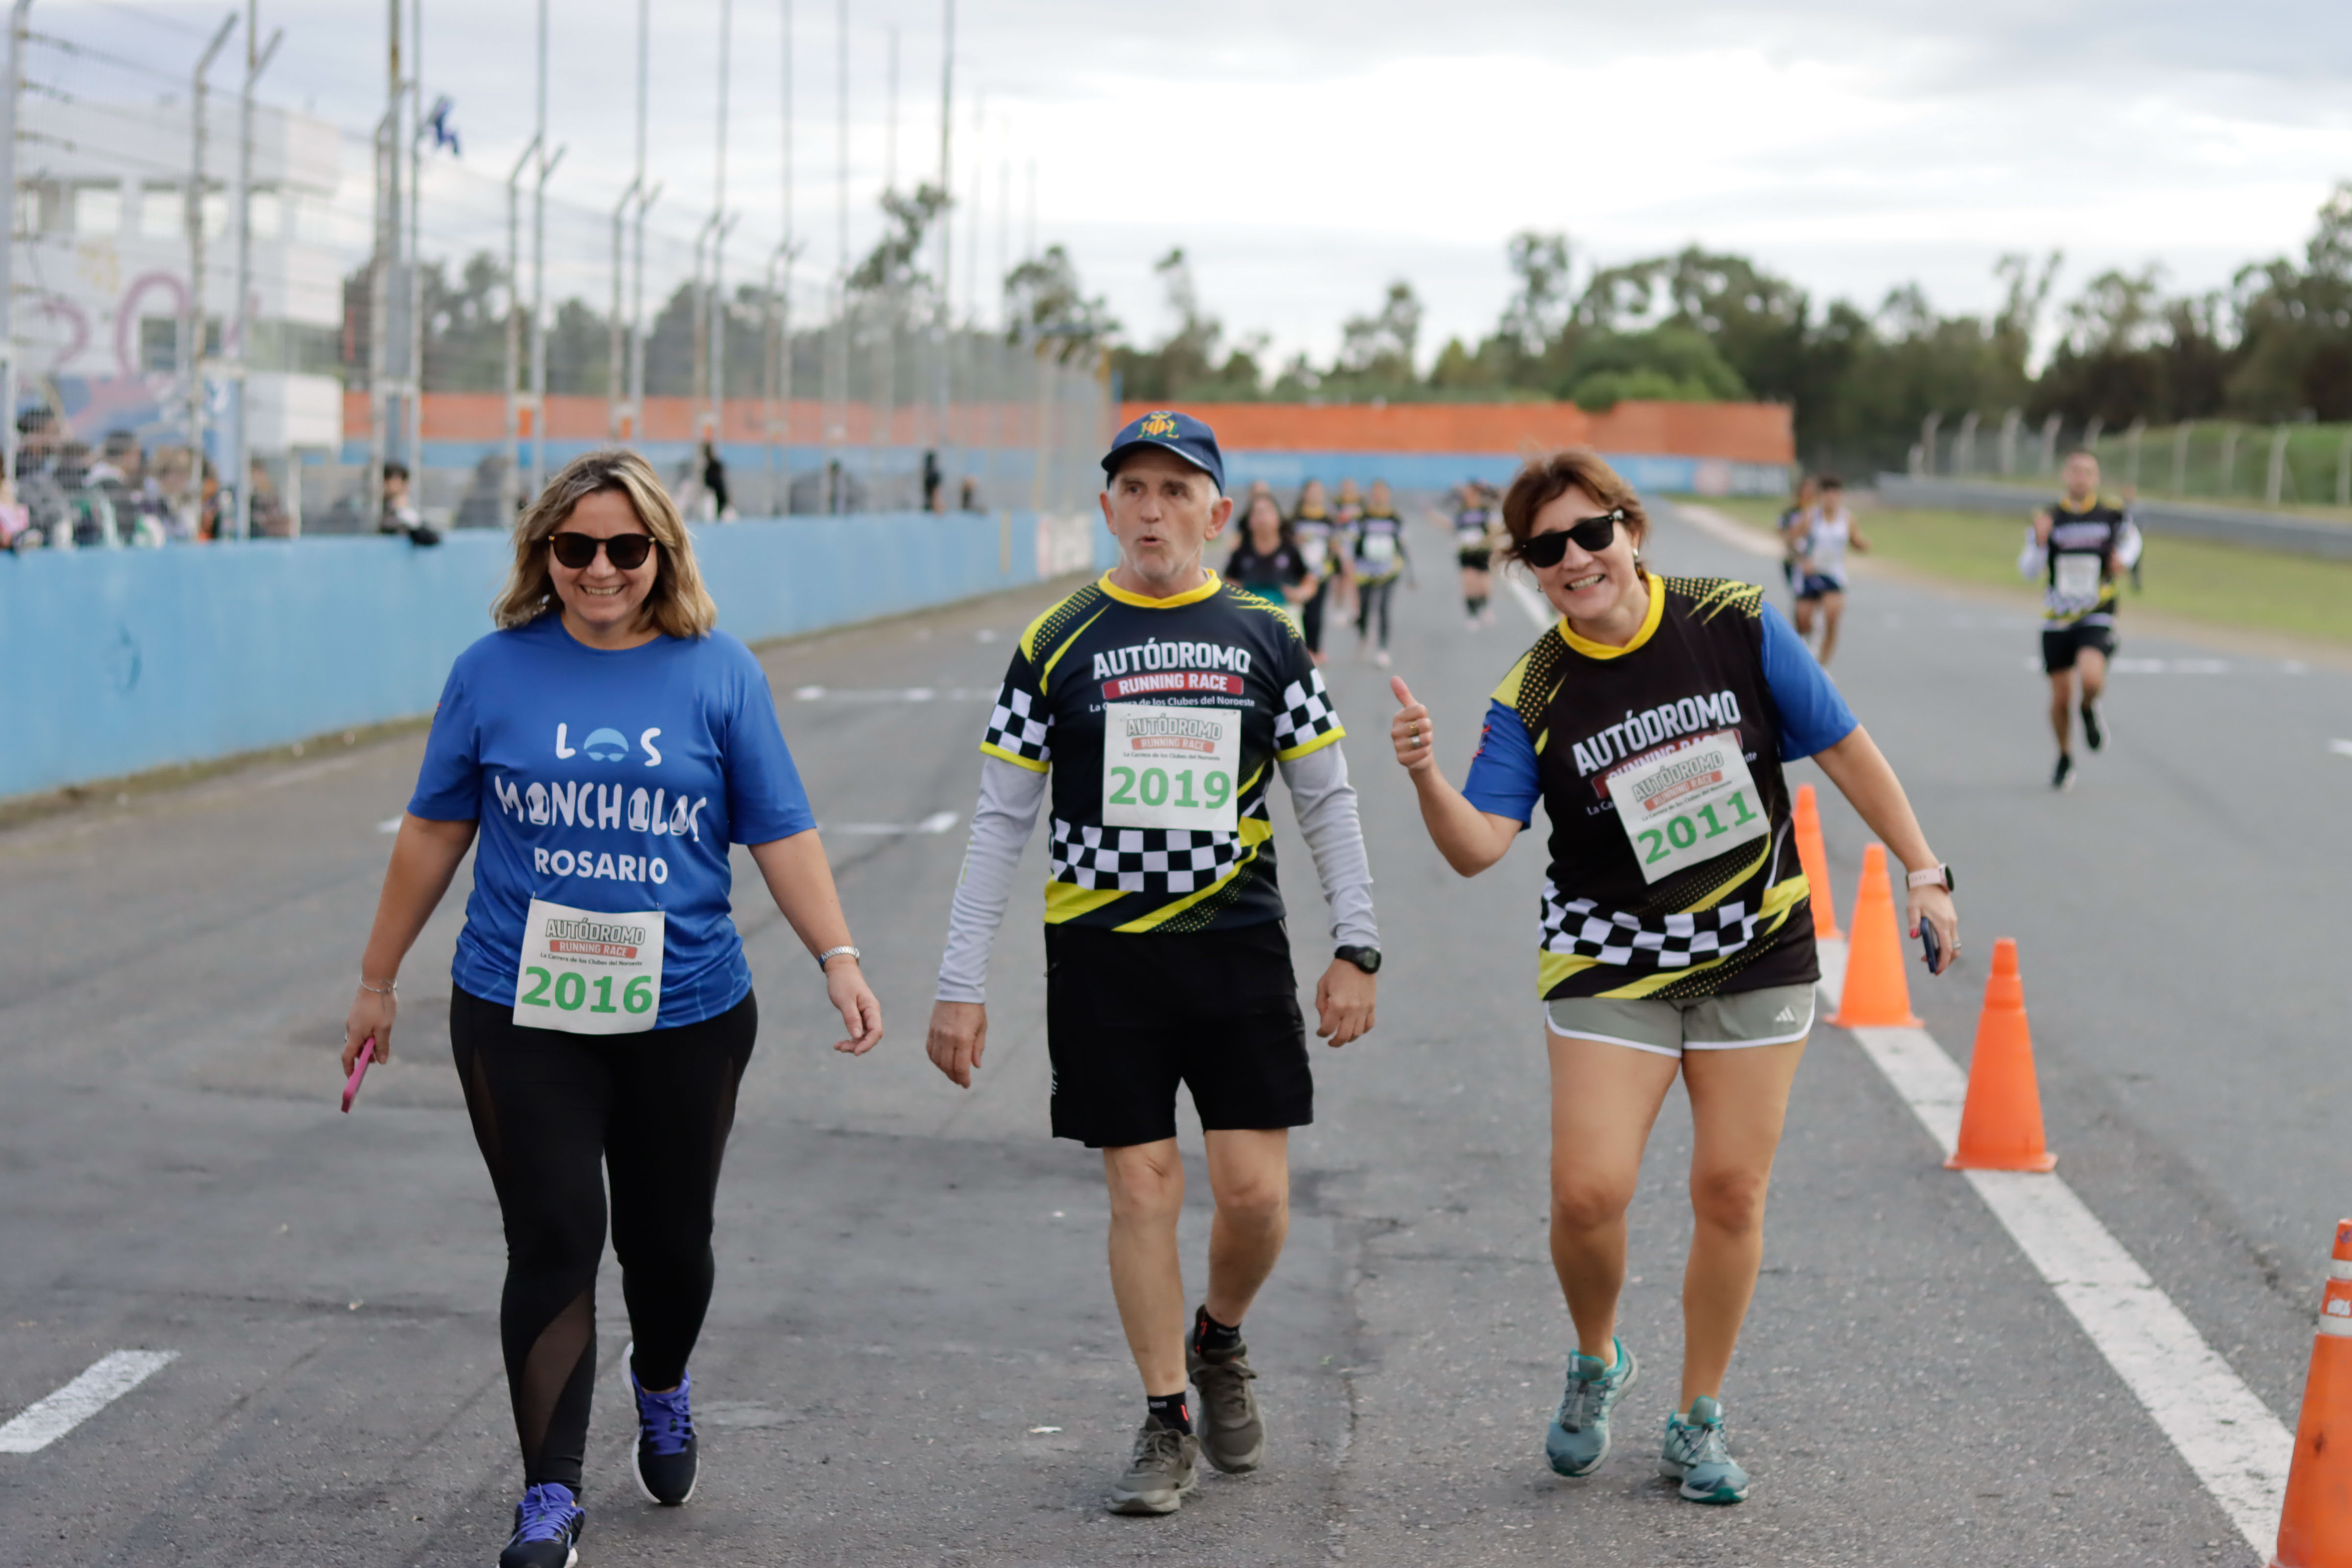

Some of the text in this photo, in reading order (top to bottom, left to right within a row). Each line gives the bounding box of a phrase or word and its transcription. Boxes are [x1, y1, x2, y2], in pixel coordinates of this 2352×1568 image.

[1093, 637, 1251, 680] AUTÓDROMO
[1118, 673, 1228, 695] RUNNING RACE
[1089, 704, 1101, 712] La
[1167, 697, 1199, 706] Clubes
[1200, 696, 1215, 705] del
[1217, 696, 1255, 707] Noroeste
[1127, 713, 1223, 740] AUTÓDROMO
[1572, 690, 1741, 777] AUTÓDROMO
[1141, 737, 1205, 751] RUNNING RACE
[1109, 766, 1231, 809] 2019
[1632, 751, 1724, 803] AUTÓDROMO
[1638, 791, 1757, 865] 2011
[535, 847, 668, 884] ROSARIO
[545, 918, 646, 945] AUTÓDROMO
[548, 953, 569, 962] Carrera
[559, 942, 628, 957] RUNNING RACE
[521, 966, 653, 1014] 2016
